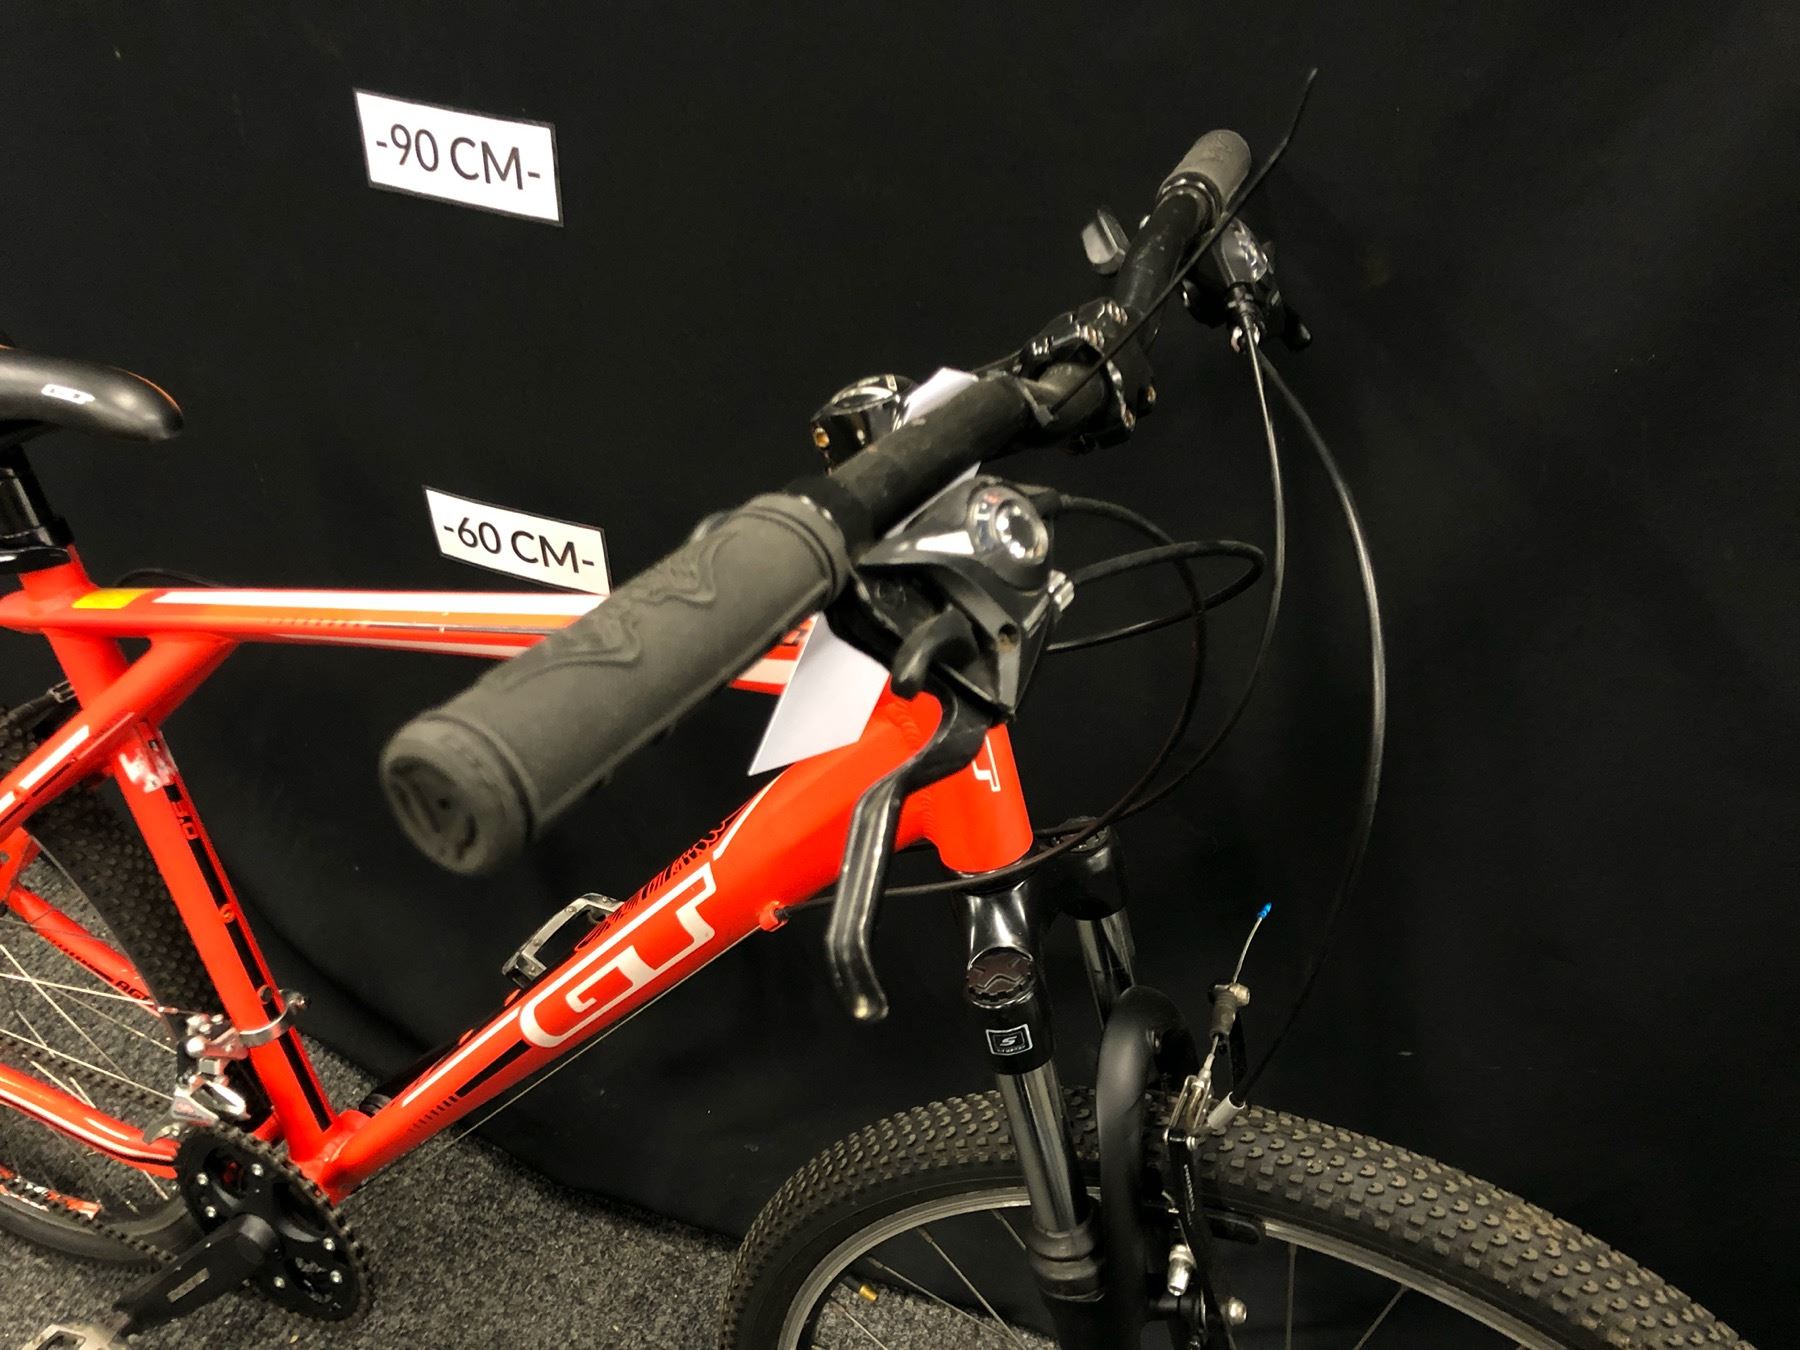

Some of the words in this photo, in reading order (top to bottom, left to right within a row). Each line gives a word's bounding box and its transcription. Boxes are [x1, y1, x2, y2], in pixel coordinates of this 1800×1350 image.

[376, 124, 439, 173] -90
[450, 137, 541, 190] CM-
[443, 517, 501, 554] -60
[511, 530, 595, 573] CM-
[520, 862, 717, 1048] GT
